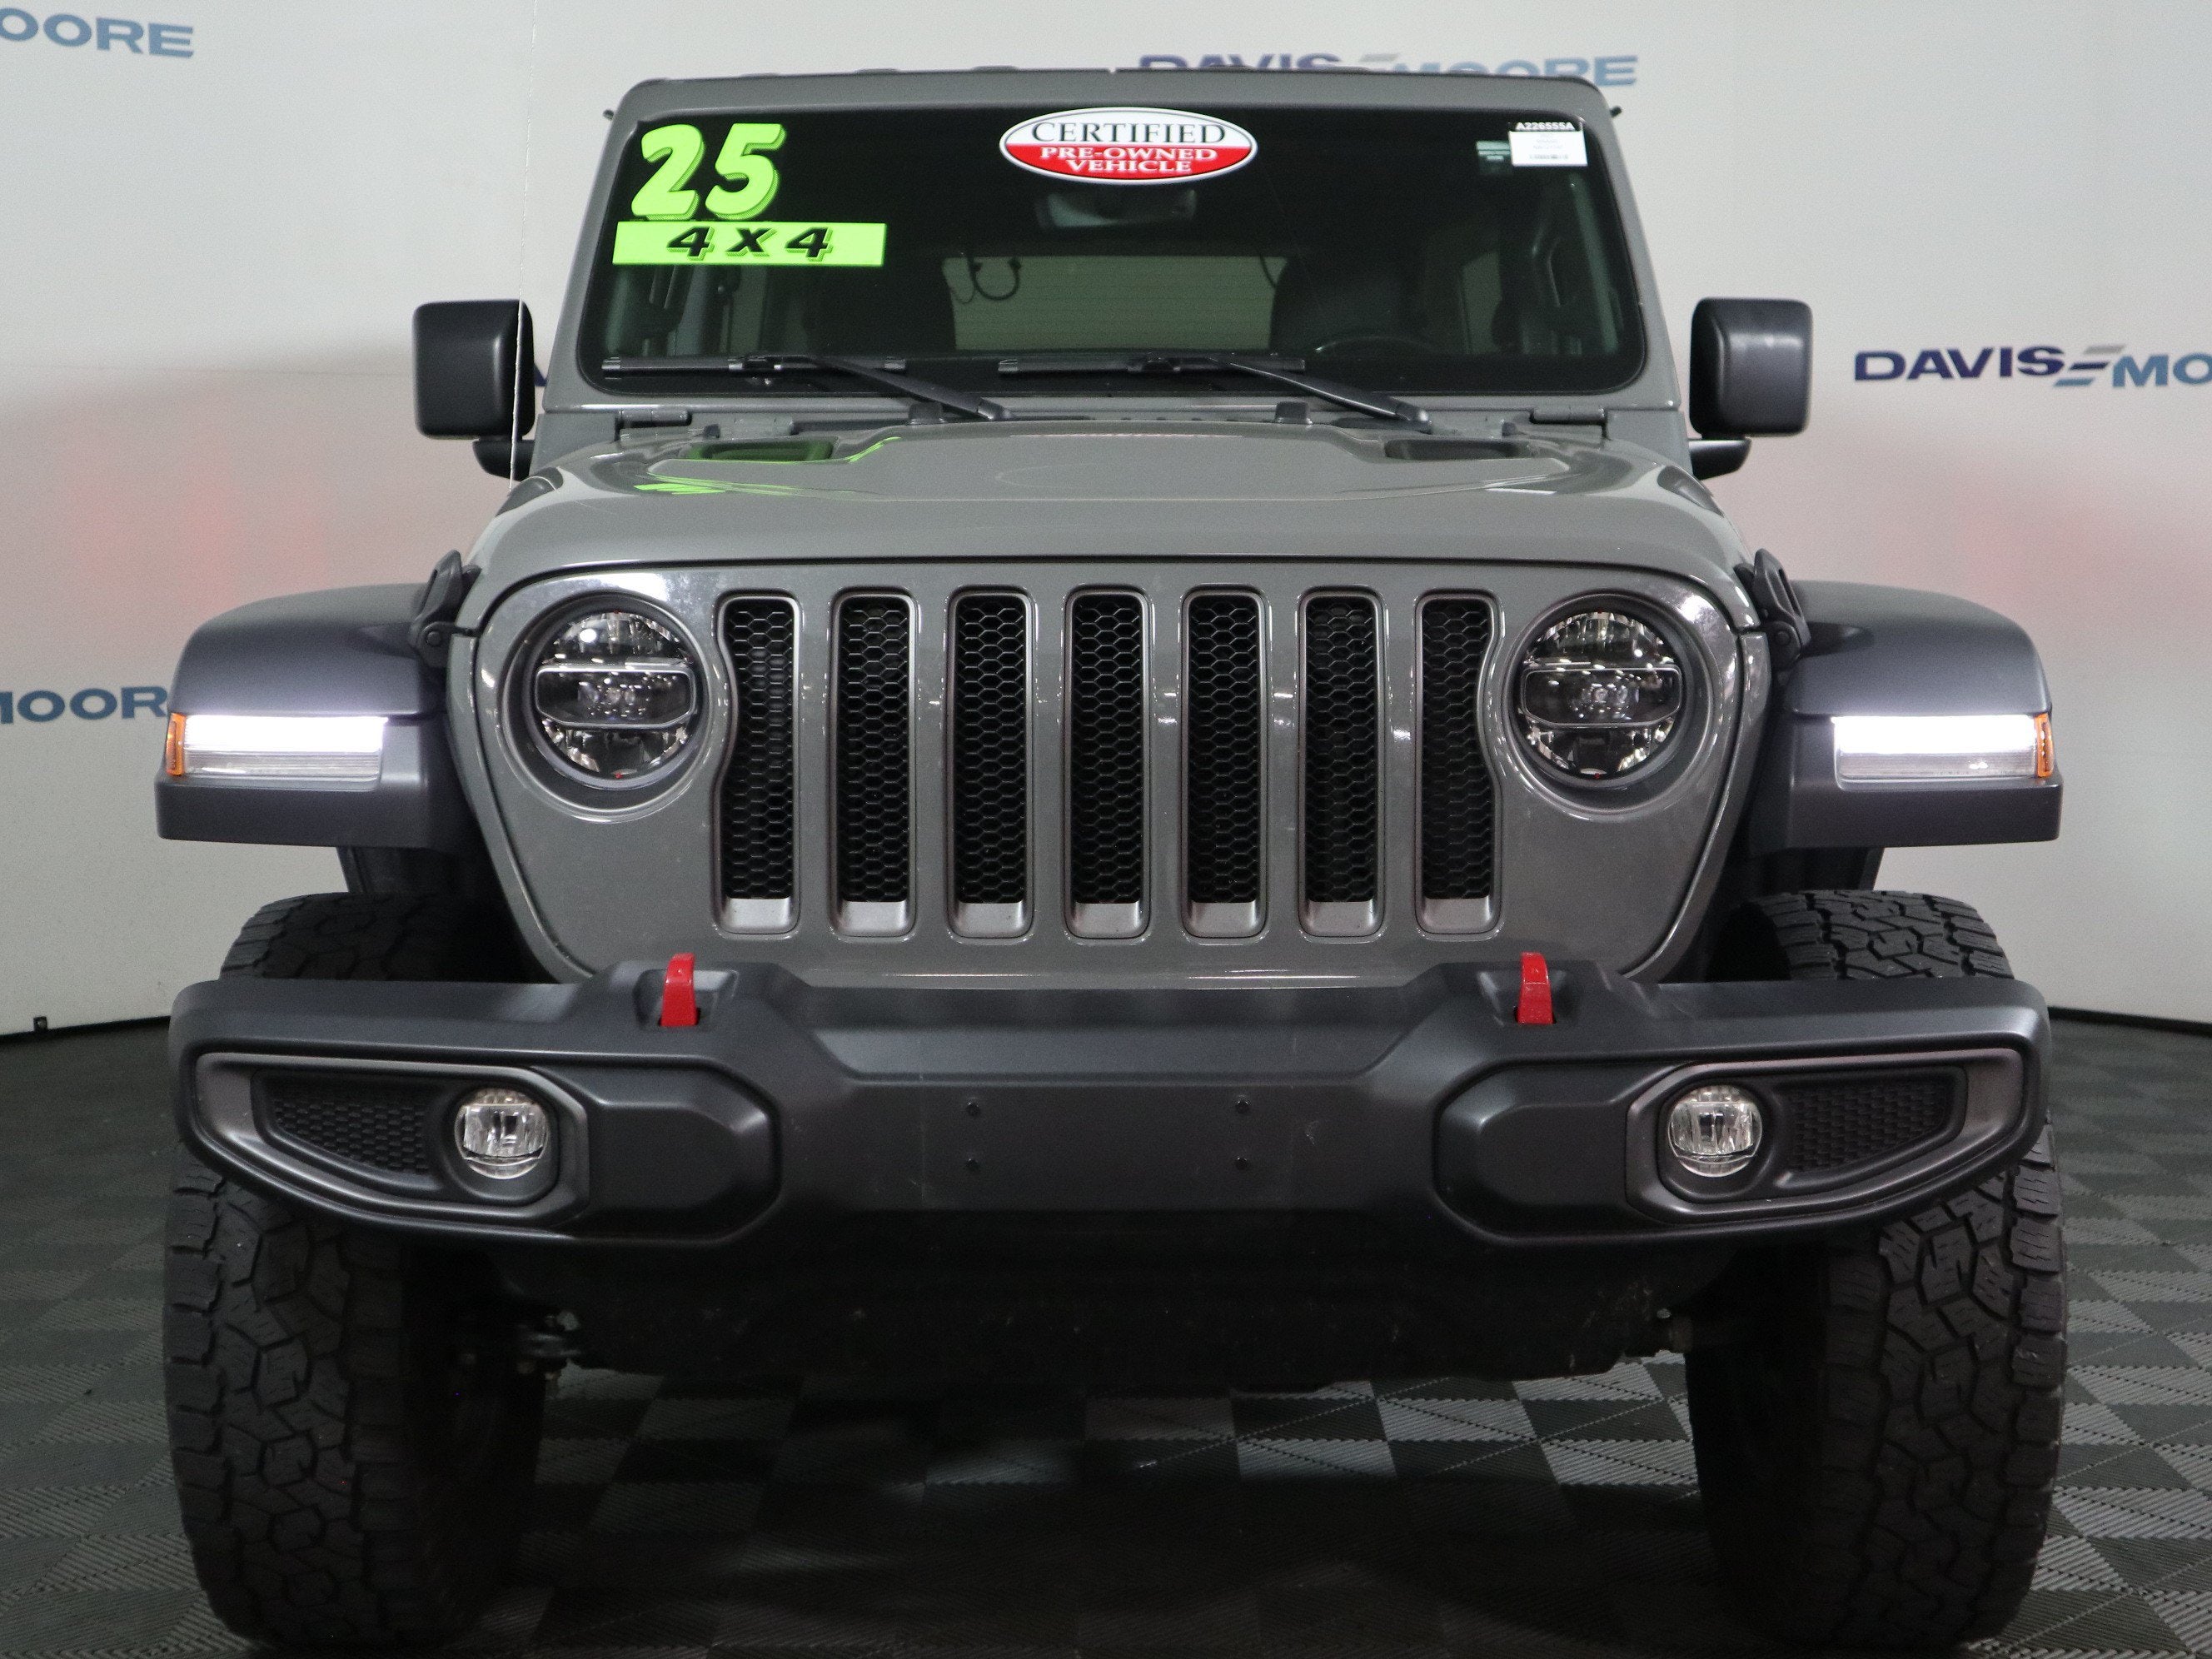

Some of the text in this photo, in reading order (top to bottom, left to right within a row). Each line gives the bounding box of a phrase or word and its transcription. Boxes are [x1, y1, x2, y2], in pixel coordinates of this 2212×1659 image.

[1032, 122, 1225, 143] CERTIFIED
[1040, 147, 1218, 160] PRE-OWNED
[1065, 159, 1193, 172] VEHICLE
[630, 122, 786, 221] 25
[1855, 345, 2065, 381] DAVIS
[0, 685, 167, 725] OOR
